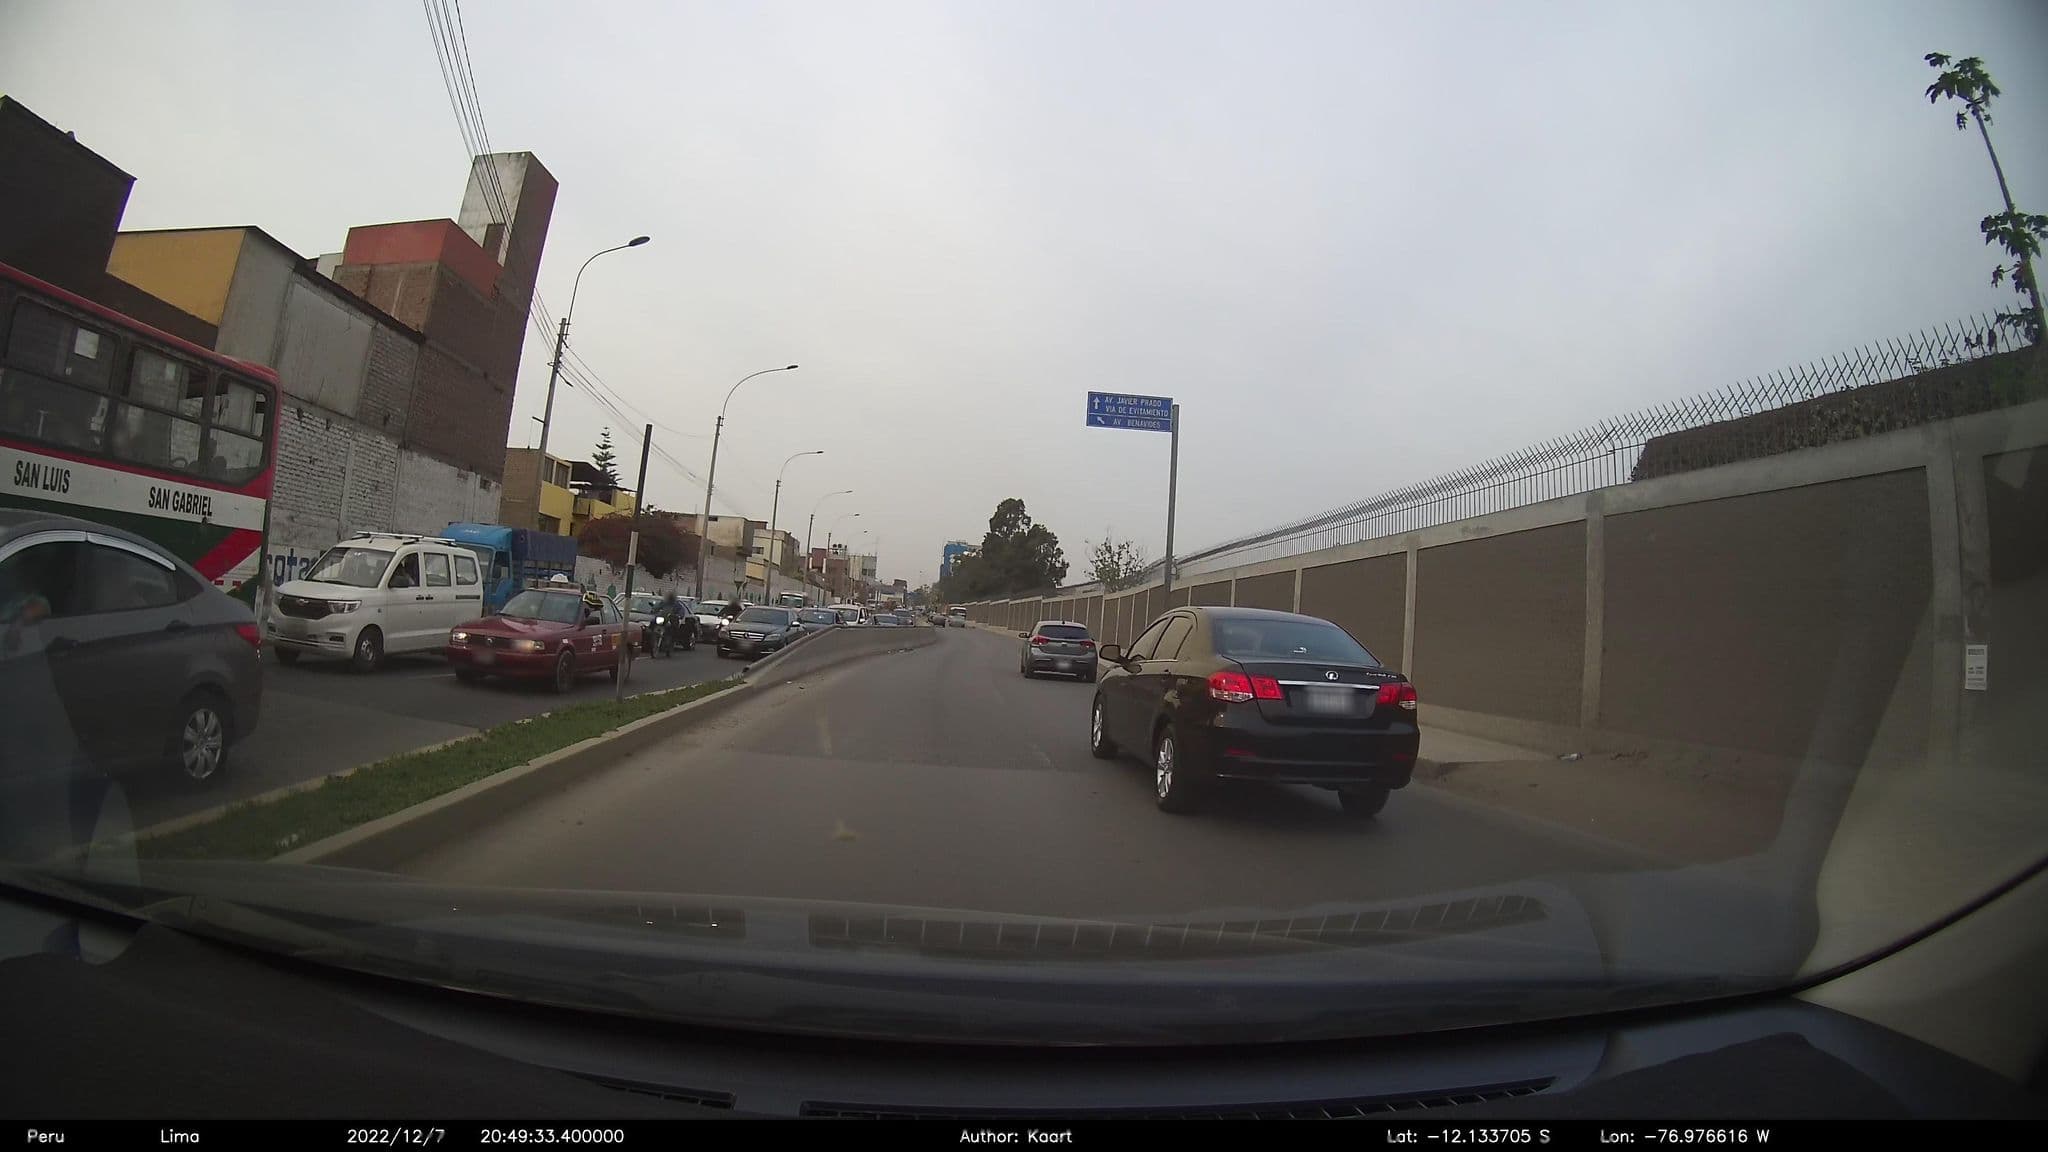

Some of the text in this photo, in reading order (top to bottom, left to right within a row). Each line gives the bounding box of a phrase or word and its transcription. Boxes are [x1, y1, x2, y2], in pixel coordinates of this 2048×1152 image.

[1118, 406, 1127, 414] DE
[1129, 408, 1169, 417] EVITAMIENTO
[1141, 399, 1162, 407] PRADO
[14, 460, 71, 493] SAN LUIS
[148, 486, 213, 516] SAN GABRIEL
